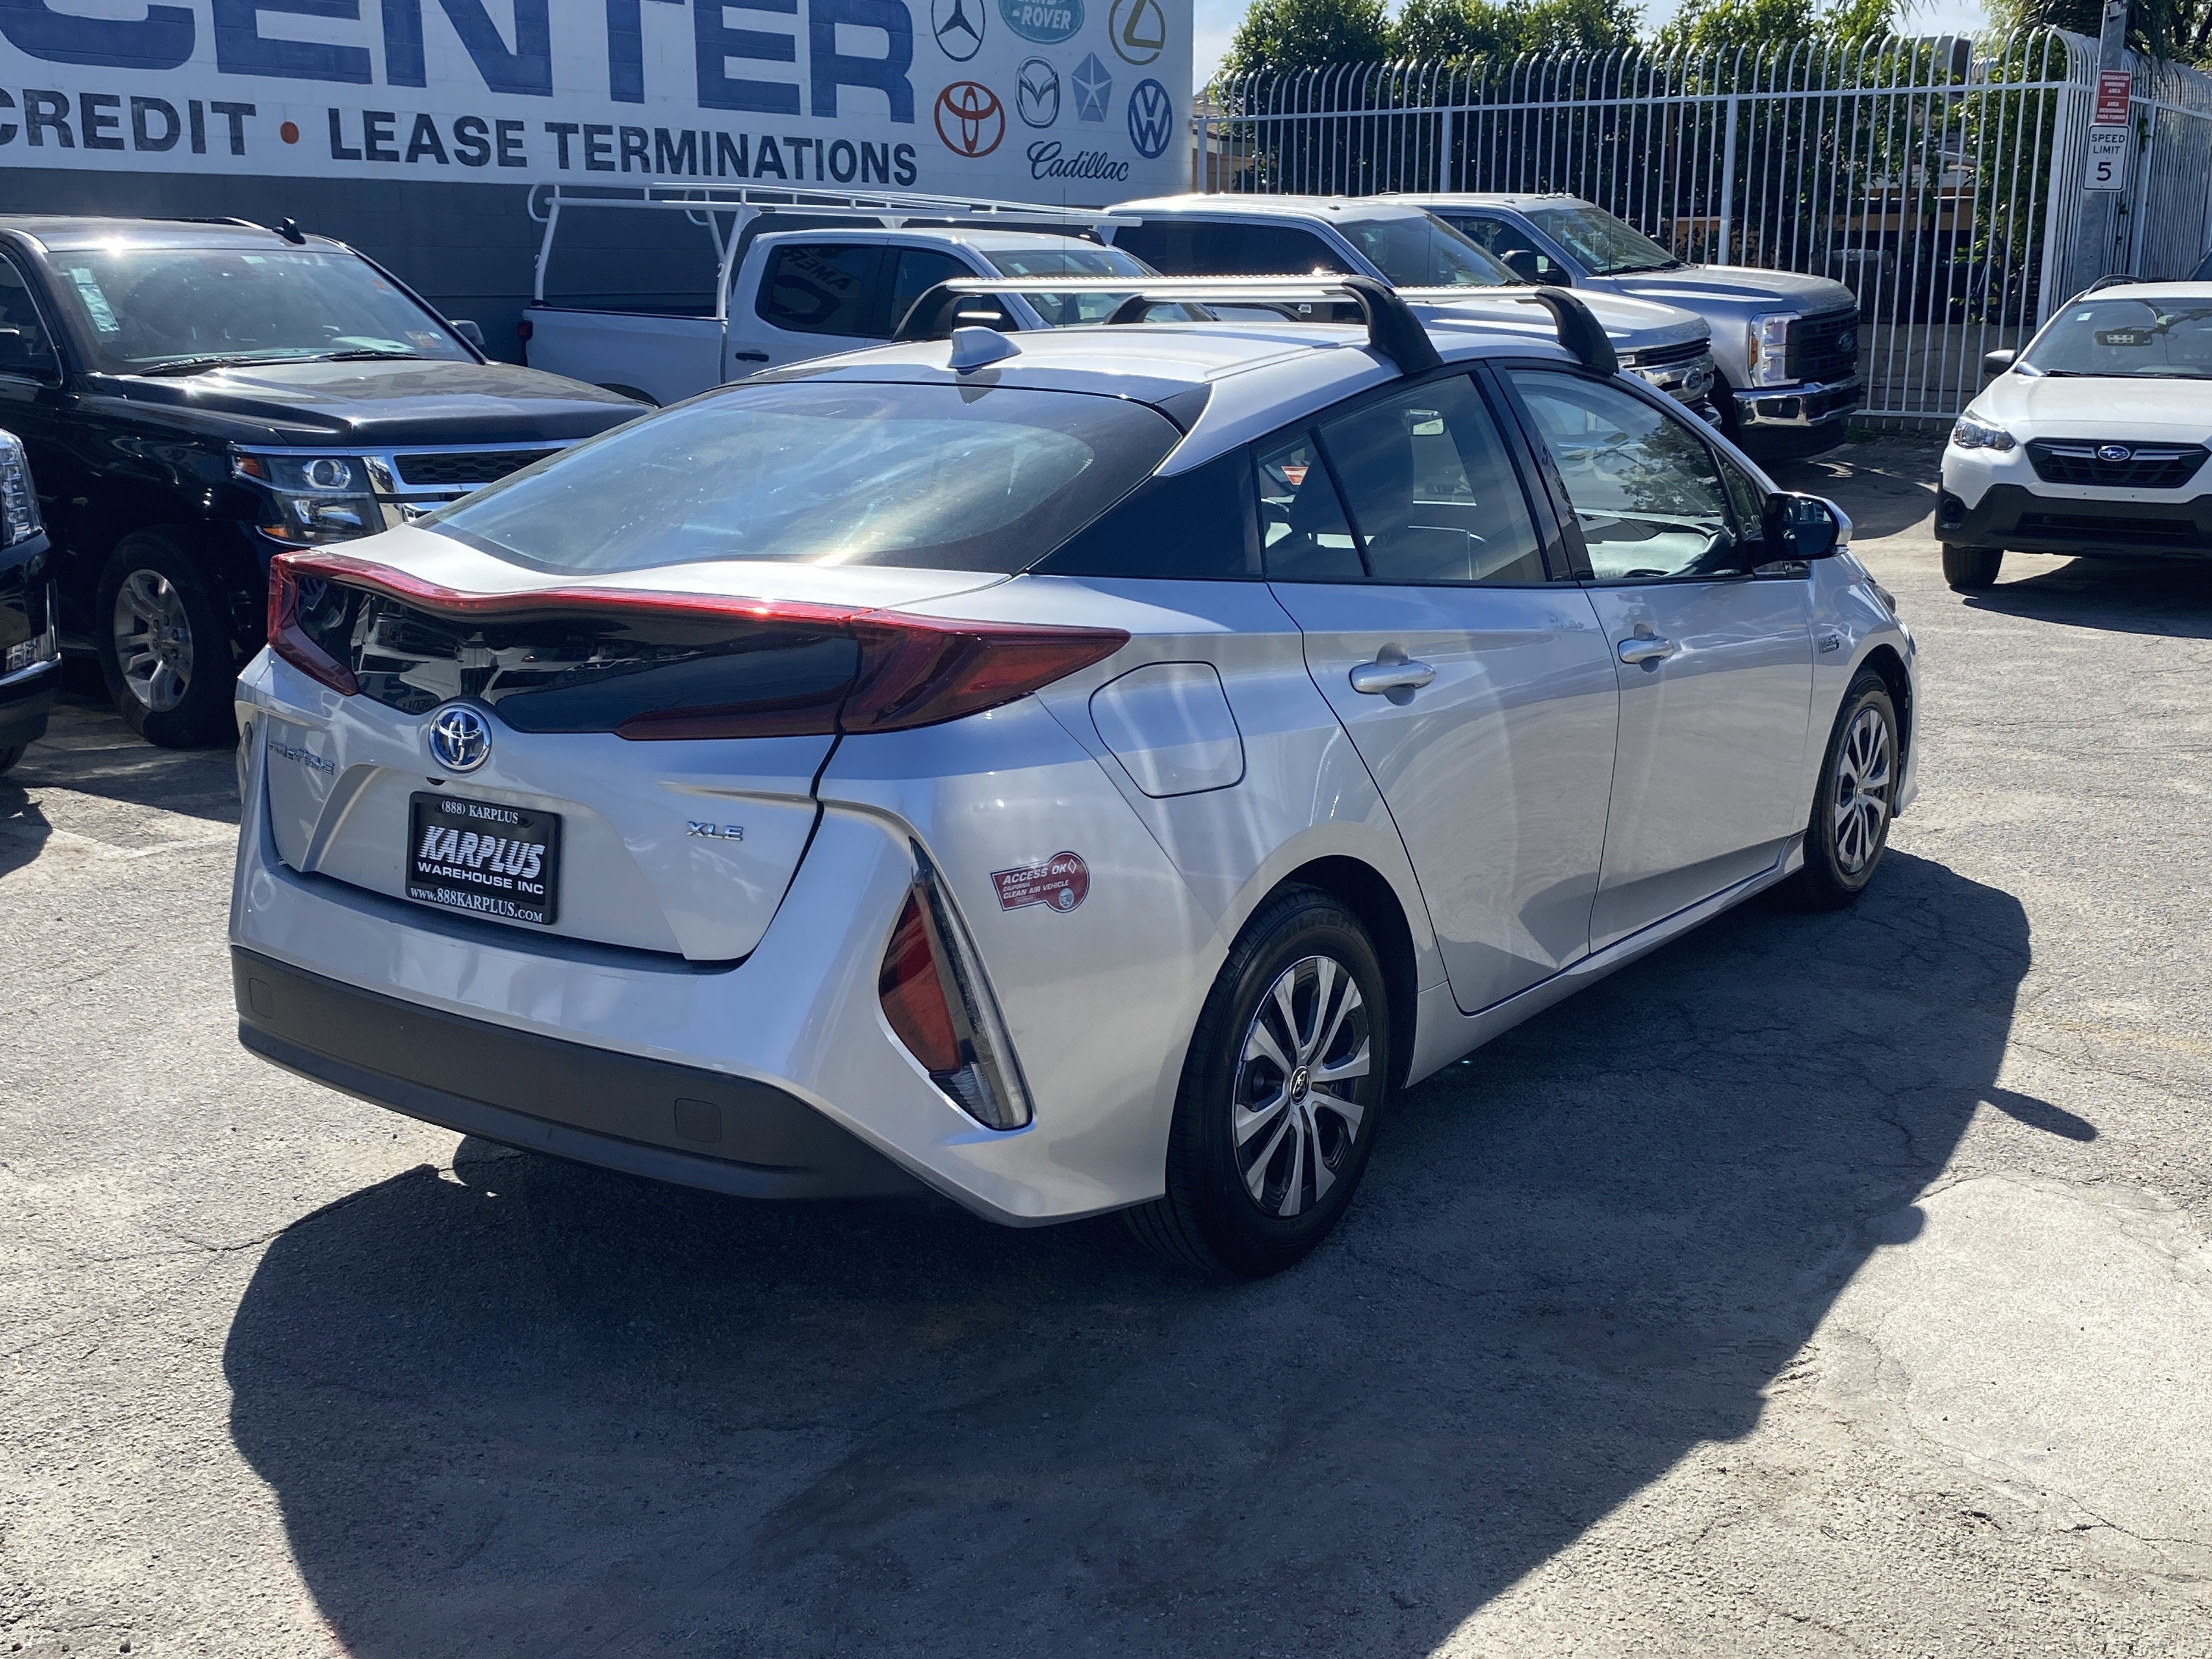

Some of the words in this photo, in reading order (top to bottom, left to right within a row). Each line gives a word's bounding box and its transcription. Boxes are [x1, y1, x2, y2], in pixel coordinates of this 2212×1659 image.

[1021, 5, 1071, 30] ROVER
[328, 108, 528, 168] LEASE
[545, 122, 917, 187] TERMINATIONS
[2091, 133, 2125, 144] SPEED
[2093, 145, 2121, 155] LIMIT
[1026, 140, 1129, 182] Cadillac
[2096, 161, 2112, 182] 5
[442, 800, 466, 816] (888)
[468, 804, 520, 824] KARPLUS
[686, 821, 744, 841] XLE
[417, 825, 545, 879] KARPLUS
[417, 861, 513, 889] WAREHOUSE
[517, 880, 544, 895] INC
[1002, 867, 1048, 885] ACCESS
[1051, 863, 1068, 875] OK
[1003, 889, 1028, 899] CLEAN
[1028, 885, 1041, 894] AIR
[1042, 879, 1070, 891] VEHICLE
